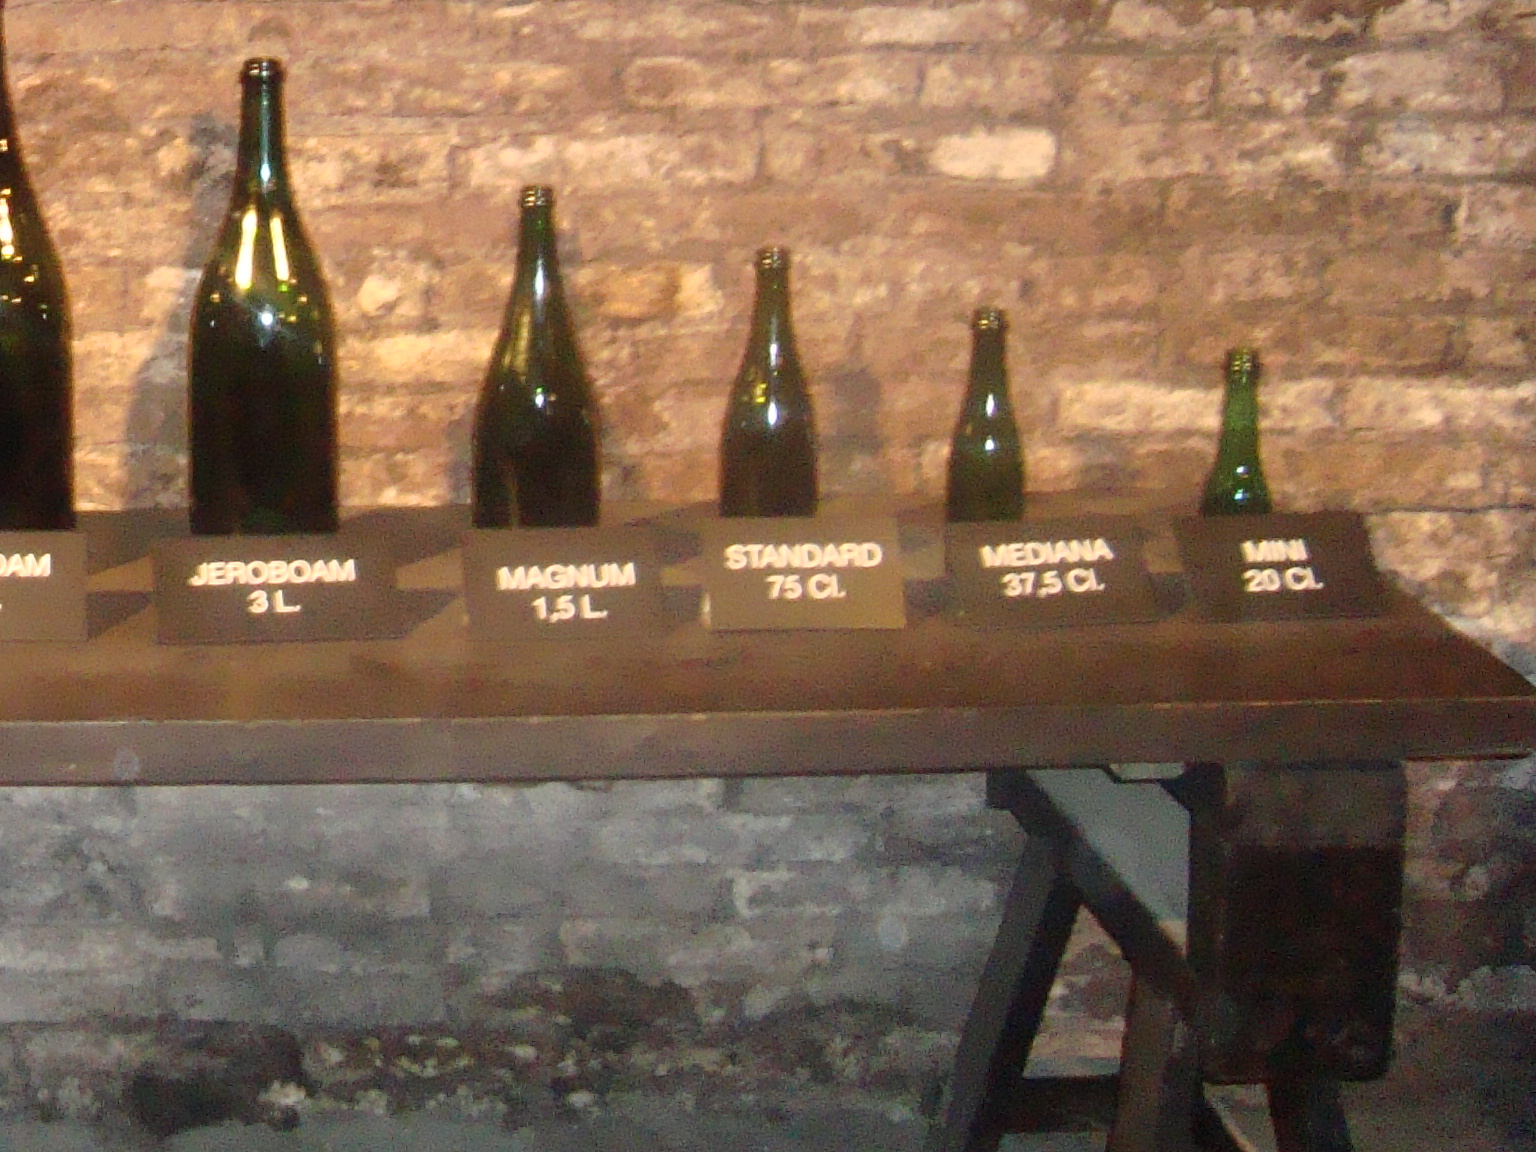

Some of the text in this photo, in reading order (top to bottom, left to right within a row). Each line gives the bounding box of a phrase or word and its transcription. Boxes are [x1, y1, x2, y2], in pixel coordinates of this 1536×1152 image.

[723, 541, 884, 570] STANDARD
[980, 538, 1114, 568] MEDIANA
[1241, 538, 1309, 563] MINI
[188, 558, 356, 586] JEROBOAM
[496, 562, 637, 590] MAGNUM
[1242, 568, 1281, 592] 20
[766, 574, 803, 599] 75
[246, 590, 269, 614] 3
